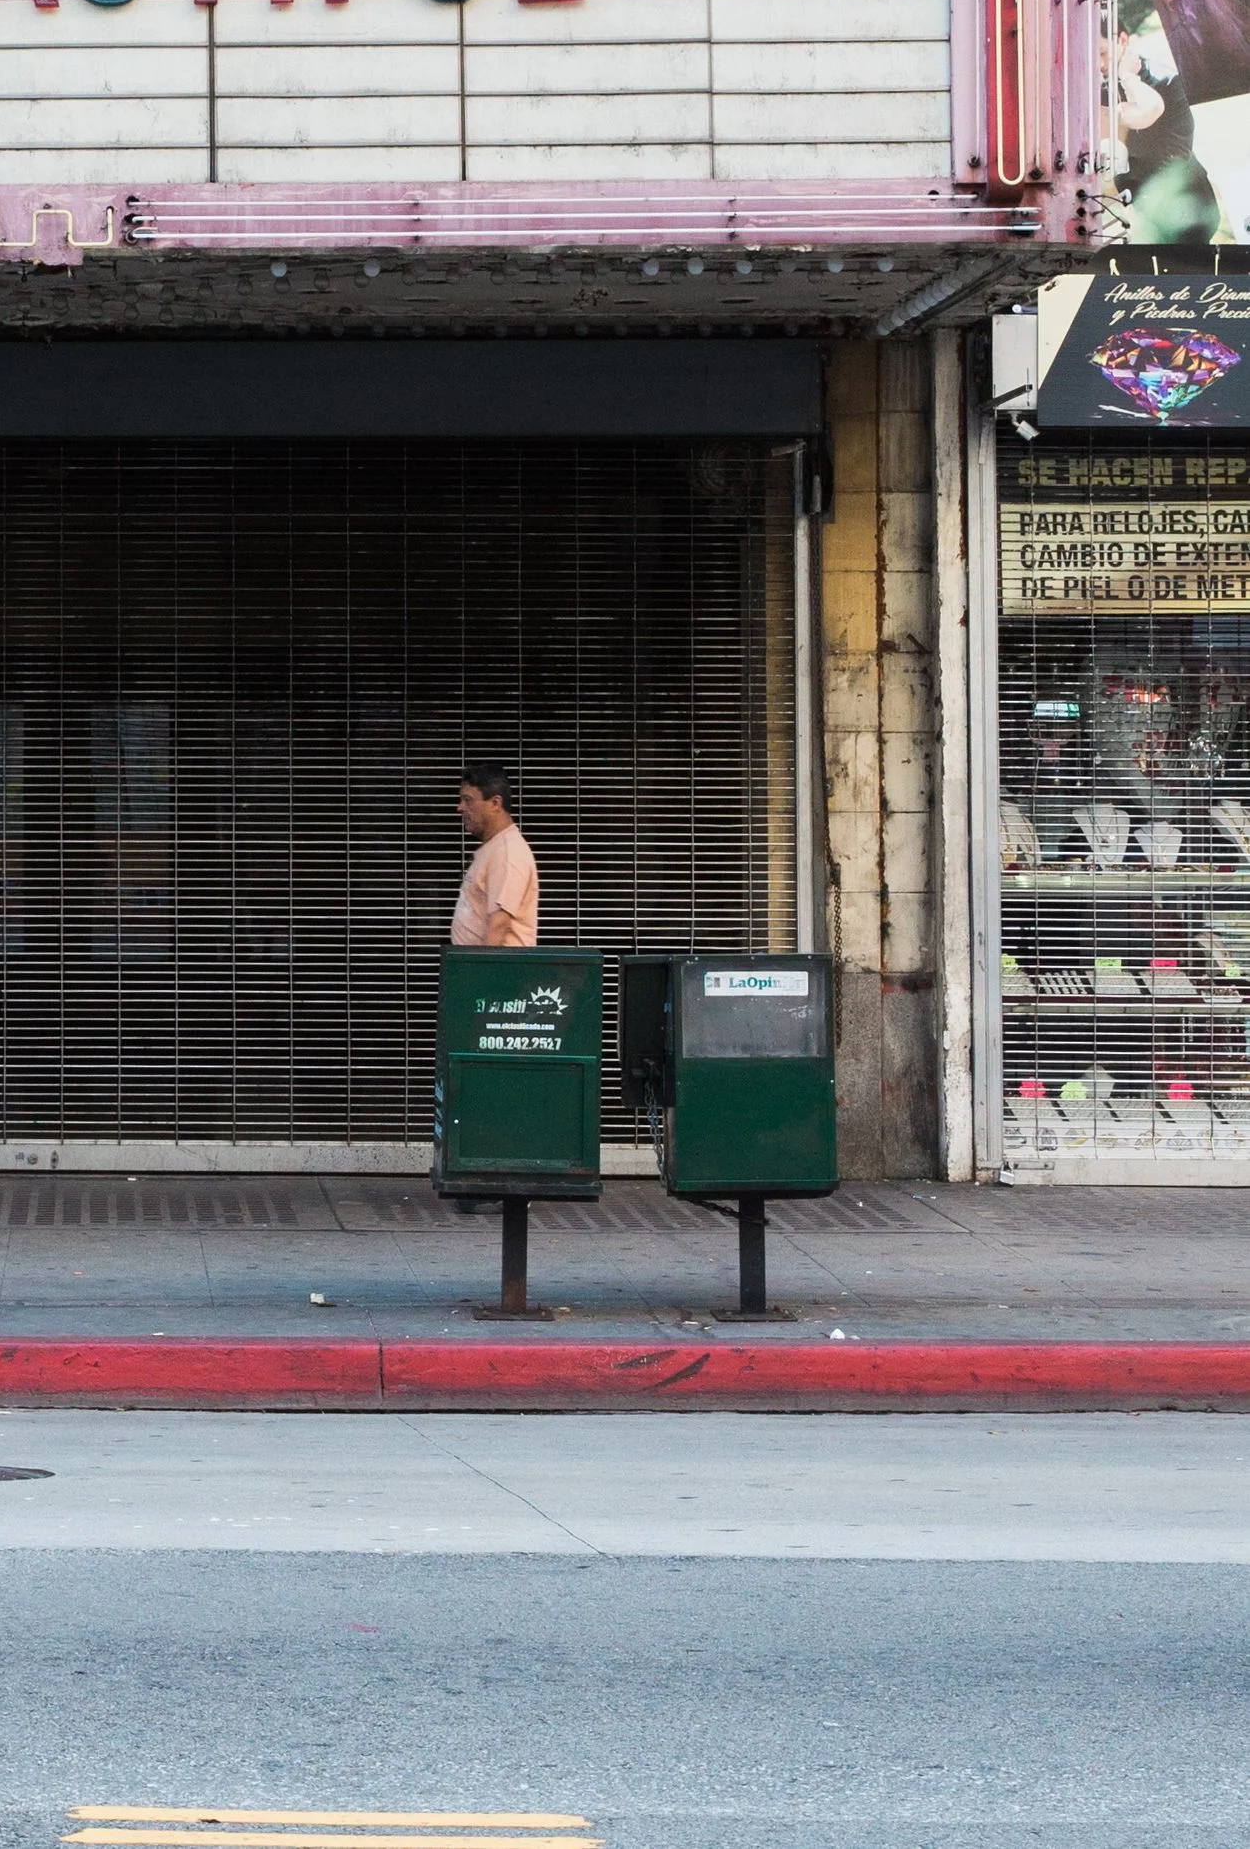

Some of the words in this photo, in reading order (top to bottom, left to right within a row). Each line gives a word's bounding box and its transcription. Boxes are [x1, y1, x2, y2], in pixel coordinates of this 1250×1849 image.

[1104, 282, 1165, 303] Anillos
[1169, 286, 1191, 301] de
[1108, 309, 1126, 326] y
[1130, 301, 1197, 319] Piedras
[1017, 457, 1056, 486] SE
[1069, 457, 1173, 485] HACEN
[1186, 457, 1250, 485] REP
[1020, 511, 1085, 536] PARA
[1093, 510, 1205, 538] RELOJES,
[1213, 509, 1250, 534] CA
[1020, 543, 1123, 568] CAMBIO
[1133, 543, 1166, 567] DE
[1021, 576, 1056, 599] DE
[1064, 576, 1119, 599] PIEL
[1128, 575, 1151, 599] O
[1155, 575, 1187, 599] DE
[478, 1036, 562, 1050] 800.242.2527
